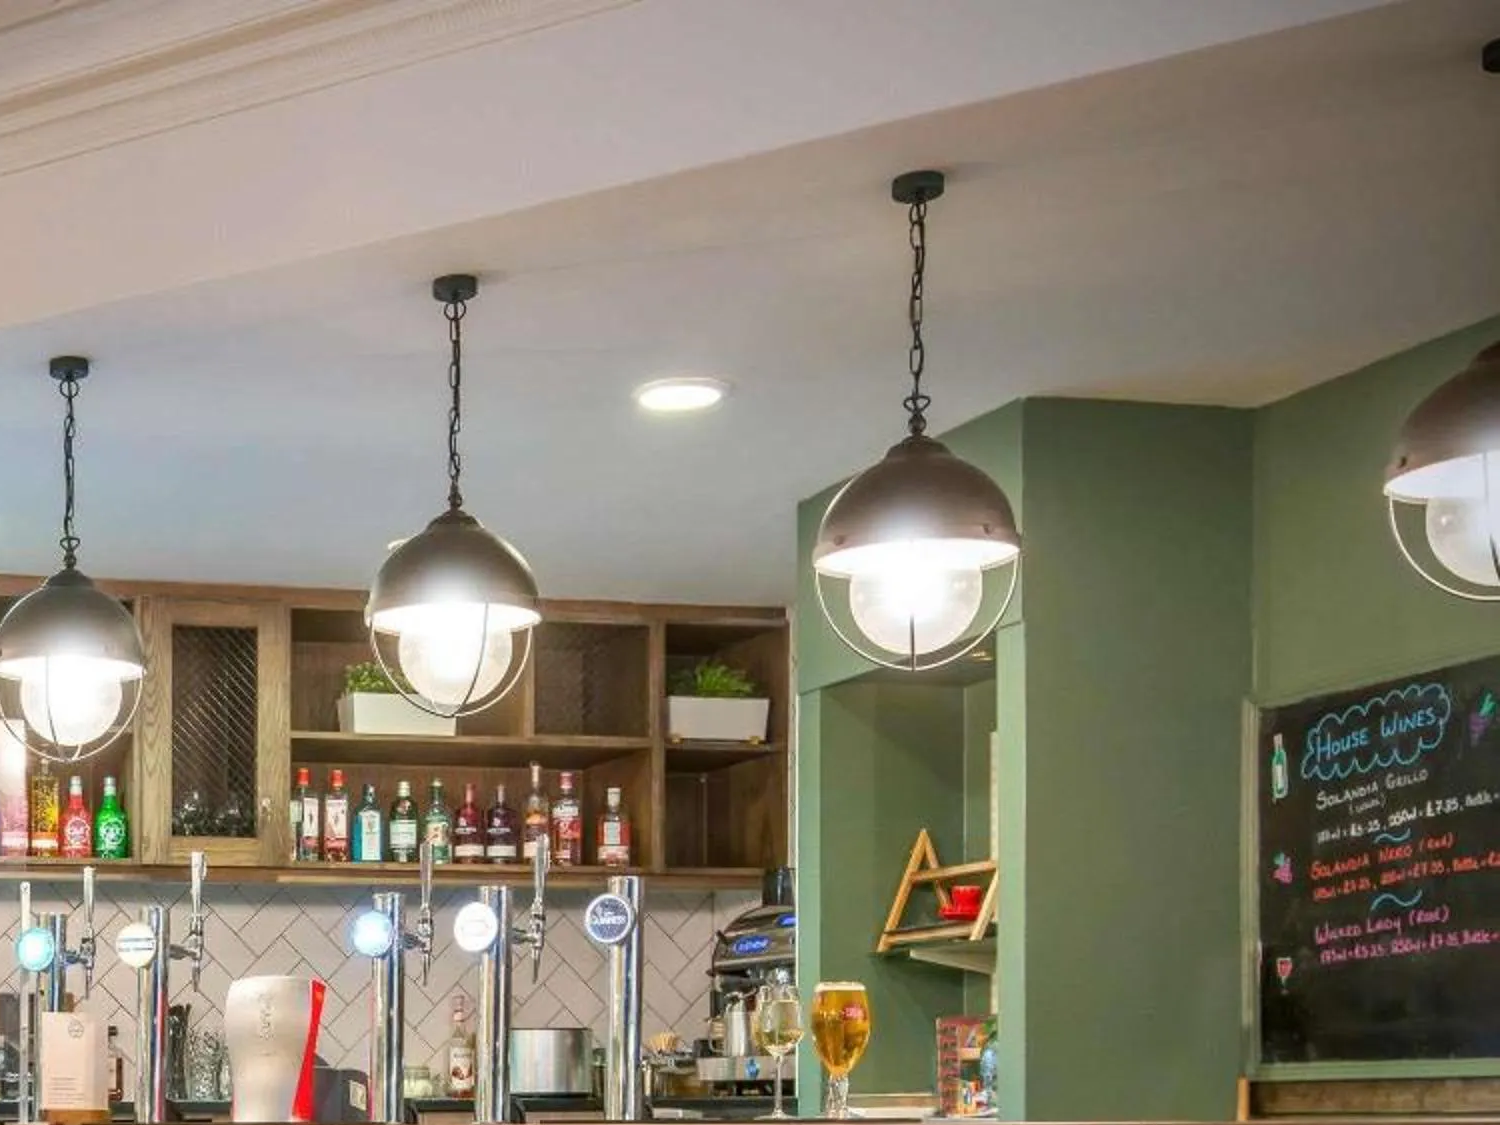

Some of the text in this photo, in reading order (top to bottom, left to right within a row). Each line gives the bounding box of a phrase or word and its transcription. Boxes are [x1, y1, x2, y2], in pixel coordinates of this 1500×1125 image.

[1315, 707, 1437, 762] HOUSE WINES
[1315, 781, 1379, 810] SOLANDIA
